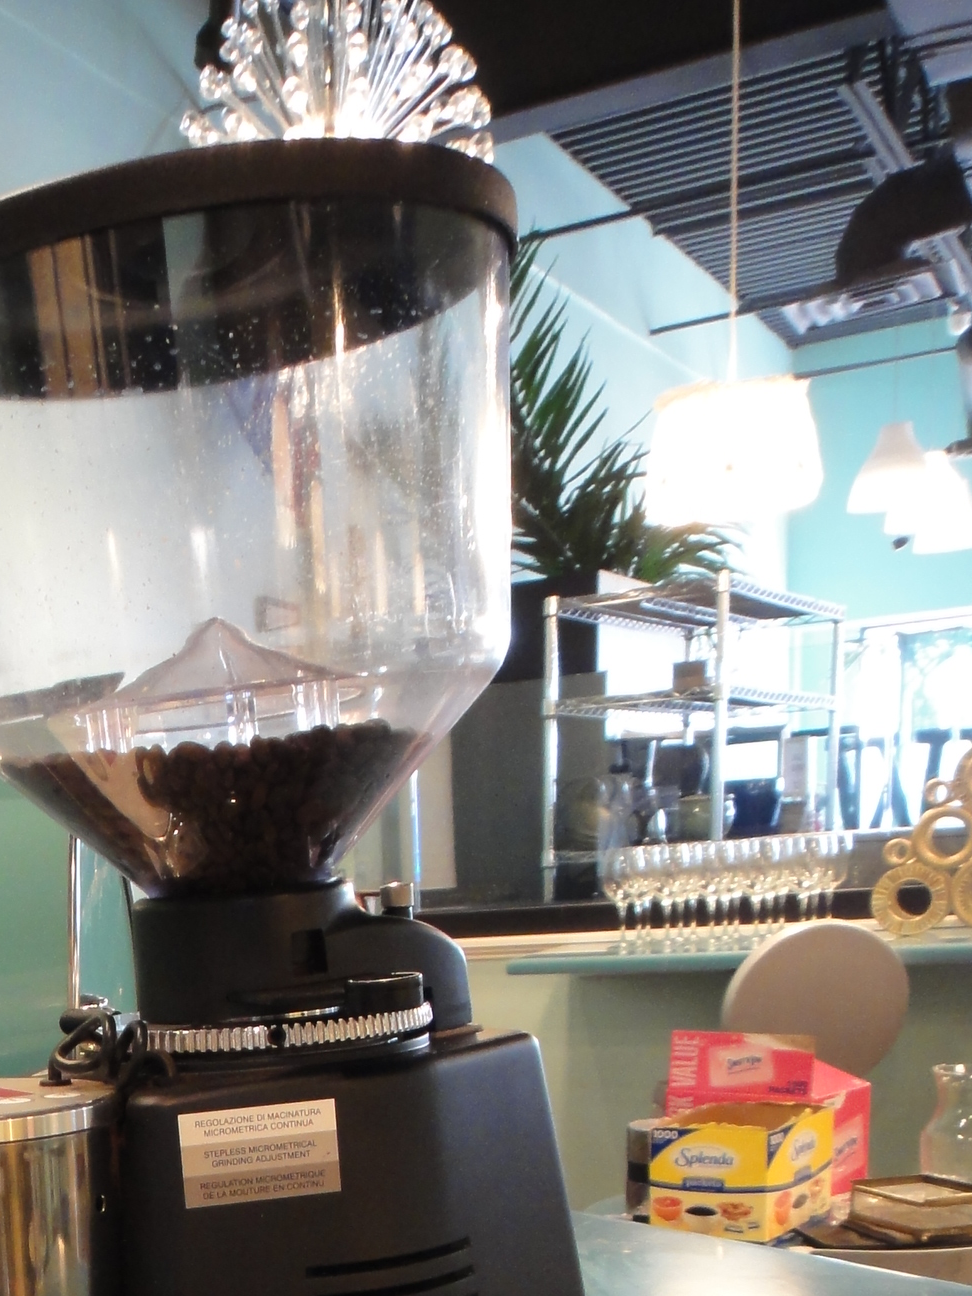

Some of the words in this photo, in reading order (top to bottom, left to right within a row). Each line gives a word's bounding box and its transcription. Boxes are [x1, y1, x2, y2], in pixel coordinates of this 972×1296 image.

[670, 1036, 699, 1086] VALUE
[194, 1114, 254, 1128] REGOLAZIONE
[256, 1113, 266, 1122] DI
[267, 1107, 322, 1121] MACINATURA
[203, 1122, 269, 1137] MICROMETRICA
[270, 1118, 314, 1131] CONTINUA
[653, 1130, 678, 1139] 1000
[203, 1147, 247, 1159] STEPLESS
[248, 1139, 317, 1154] MICROMETRICAL
[211, 1156, 254, 1168] GRINDING
[255, 1150, 311, 1163] ADJUSTMENT
[674, 1147, 734, 1168] Splenda
[199, 1176, 254, 1190] REGULATION
[255, 1169, 326, 1185] MICROMETRIQUE
[203, 1191, 215, 1201] DE
[216, 1190, 228, 1199] LA
[229, 1184, 270, 1197] MOUTURE
[273, 1183, 285, 1192] EN
[286, 1179, 325, 1191] CONTINU
